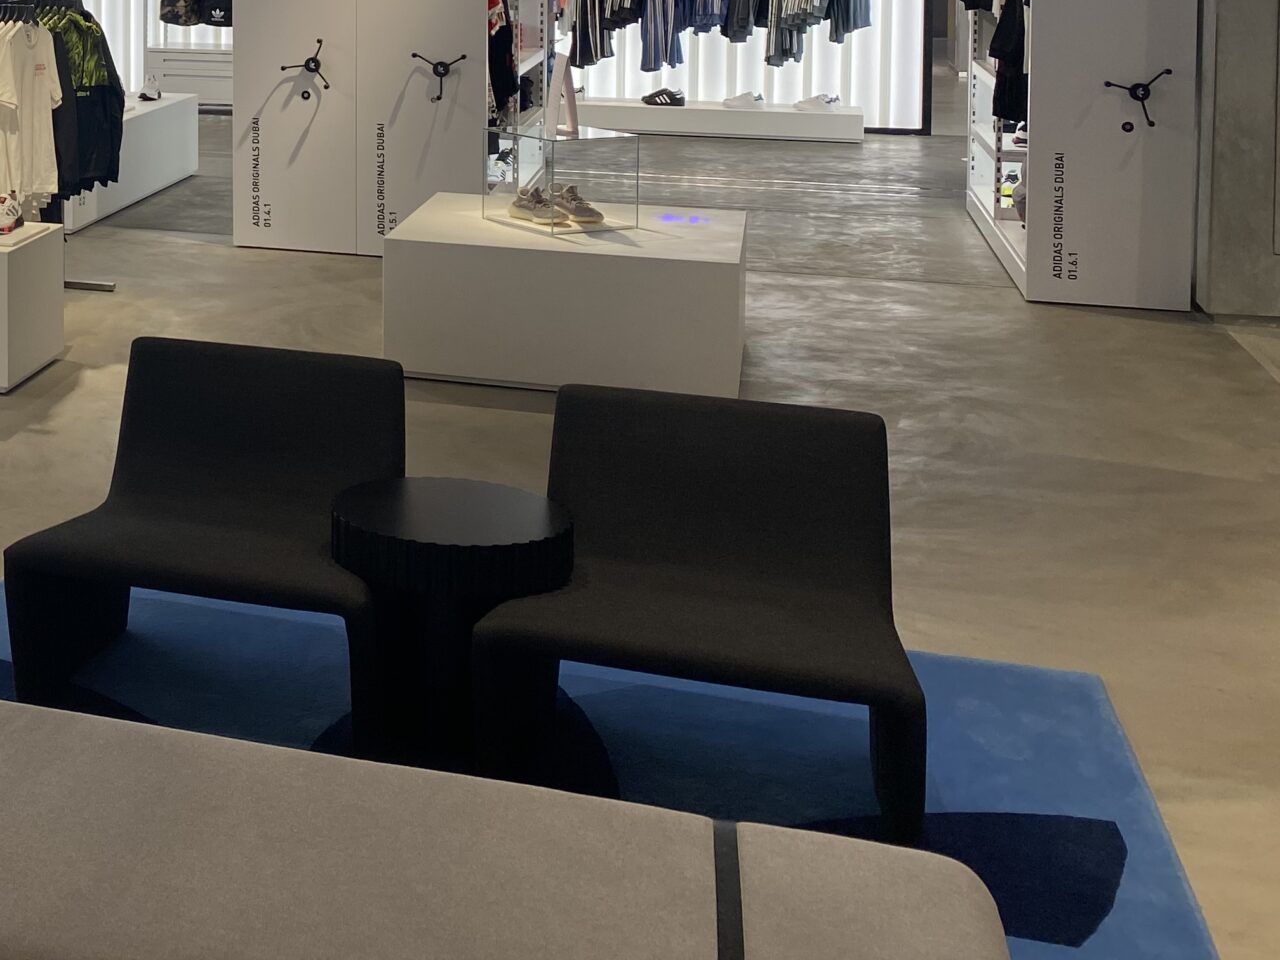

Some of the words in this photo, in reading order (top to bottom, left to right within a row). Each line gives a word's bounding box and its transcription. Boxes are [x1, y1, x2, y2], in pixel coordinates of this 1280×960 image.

[251, 117, 260, 144] DUBAI
[376, 123, 385, 151] DUBAI
[251, 146, 260, 193] ORIGINALS
[376, 152, 385, 201] ORIGINALS
[1054, 152, 1065, 183] DUBAI
[252, 194, 260, 227] ADIDAS
[263, 203, 271, 228] 01.4.1
[377, 202, 385, 236] ADIDAS
[389, 211, 397, 231] 1.5.1
[1053, 185, 1064, 240] ORIGINALS
[1052, 242, 1063, 280] ADIDAS
[1067, 252, 1078, 281] 01.6.1
